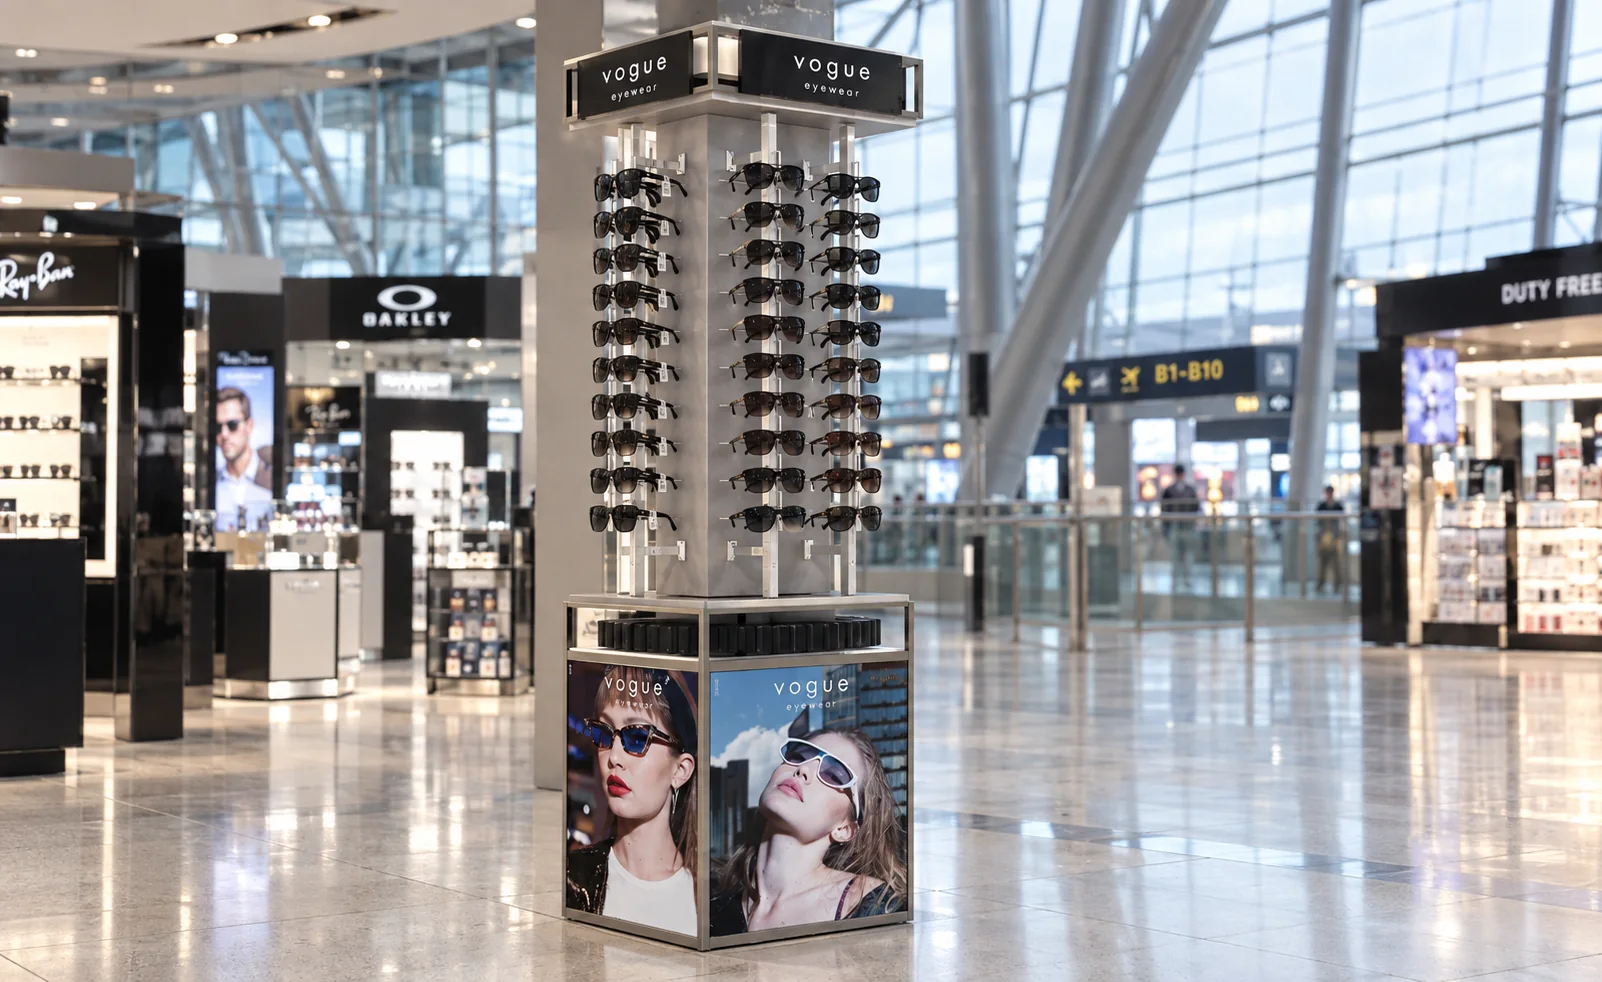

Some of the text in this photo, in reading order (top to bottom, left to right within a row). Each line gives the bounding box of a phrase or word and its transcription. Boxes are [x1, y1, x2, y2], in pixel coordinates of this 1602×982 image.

[602, 54, 668, 84] vogue
[793, 53, 871, 81] vogue
[611, 83, 658, 103] eyewear
[804, 81, 860, 99] eyewear
[1501, 272, 1602, 305] DUTY FREE
[362, 311, 452, 327] OAKLEY
[1154, 358, 1224, 384] B1-B10
[604, 676, 663, 698] vogue
[773, 678, 849, 699] vogue
[786, 701, 837, 712] eyewear
